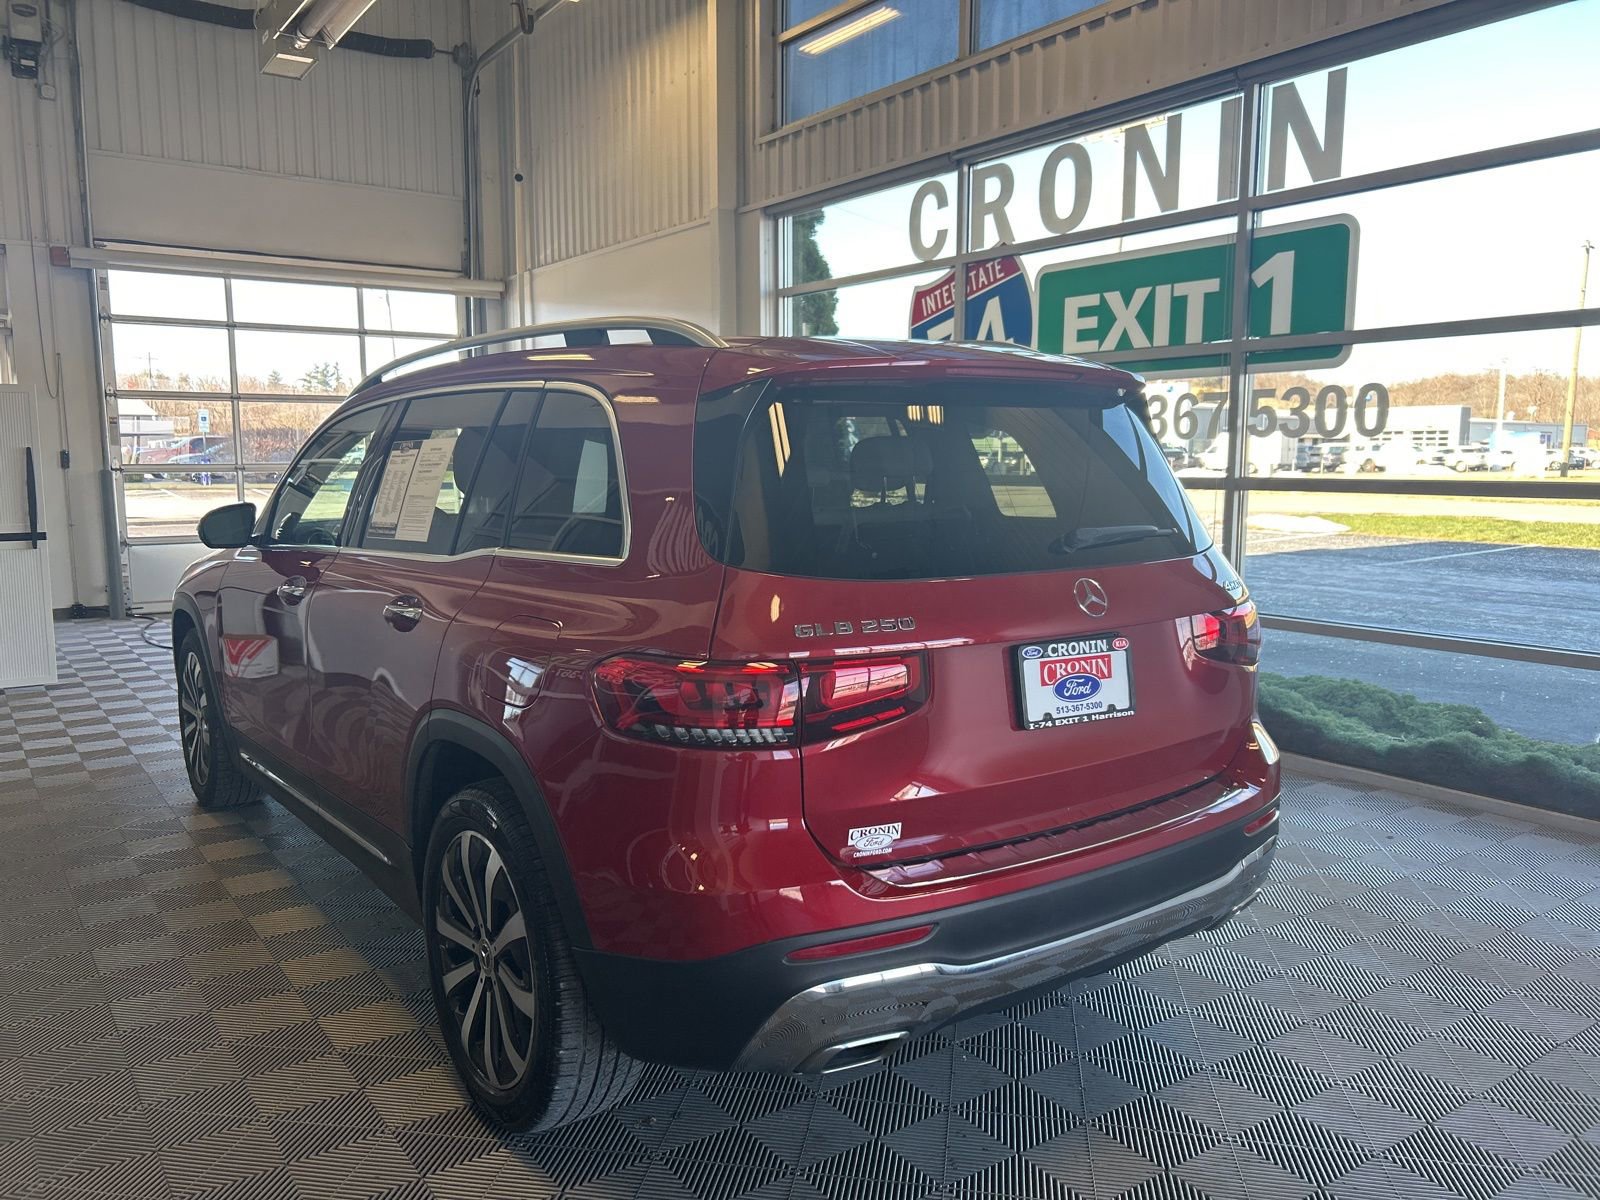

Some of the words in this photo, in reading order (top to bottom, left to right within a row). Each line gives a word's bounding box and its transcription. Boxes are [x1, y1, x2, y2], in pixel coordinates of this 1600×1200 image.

[909, 66, 1348, 261] CRONIN
[921, 259, 1004, 317] INTETATE
[1063, 278, 1220, 355] EXIT
[1251, 250, 1295, 336] 1
[794, 621, 854, 638] GLB
[860, 616, 916, 633] 250
[1047, 639, 1107, 657] CRONIN
[1115, 640, 1127, 648] KIA
[1043, 657, 1109, 685] CRONIN
[1063, 678, 1092, 697] Ford
[1056, 701, 1103, 715] 513-367-5300
[1029, 720, 1053, 730] I-74
[1055, 717, 1080, 727] EXIT
[1091, 710, 1135, 721] Harrison
[850, 824, 900, 841] CRONIN
[863, 837, 885, 848] Ford
[854, 848, 892, 858] CRONINFORD.COM
